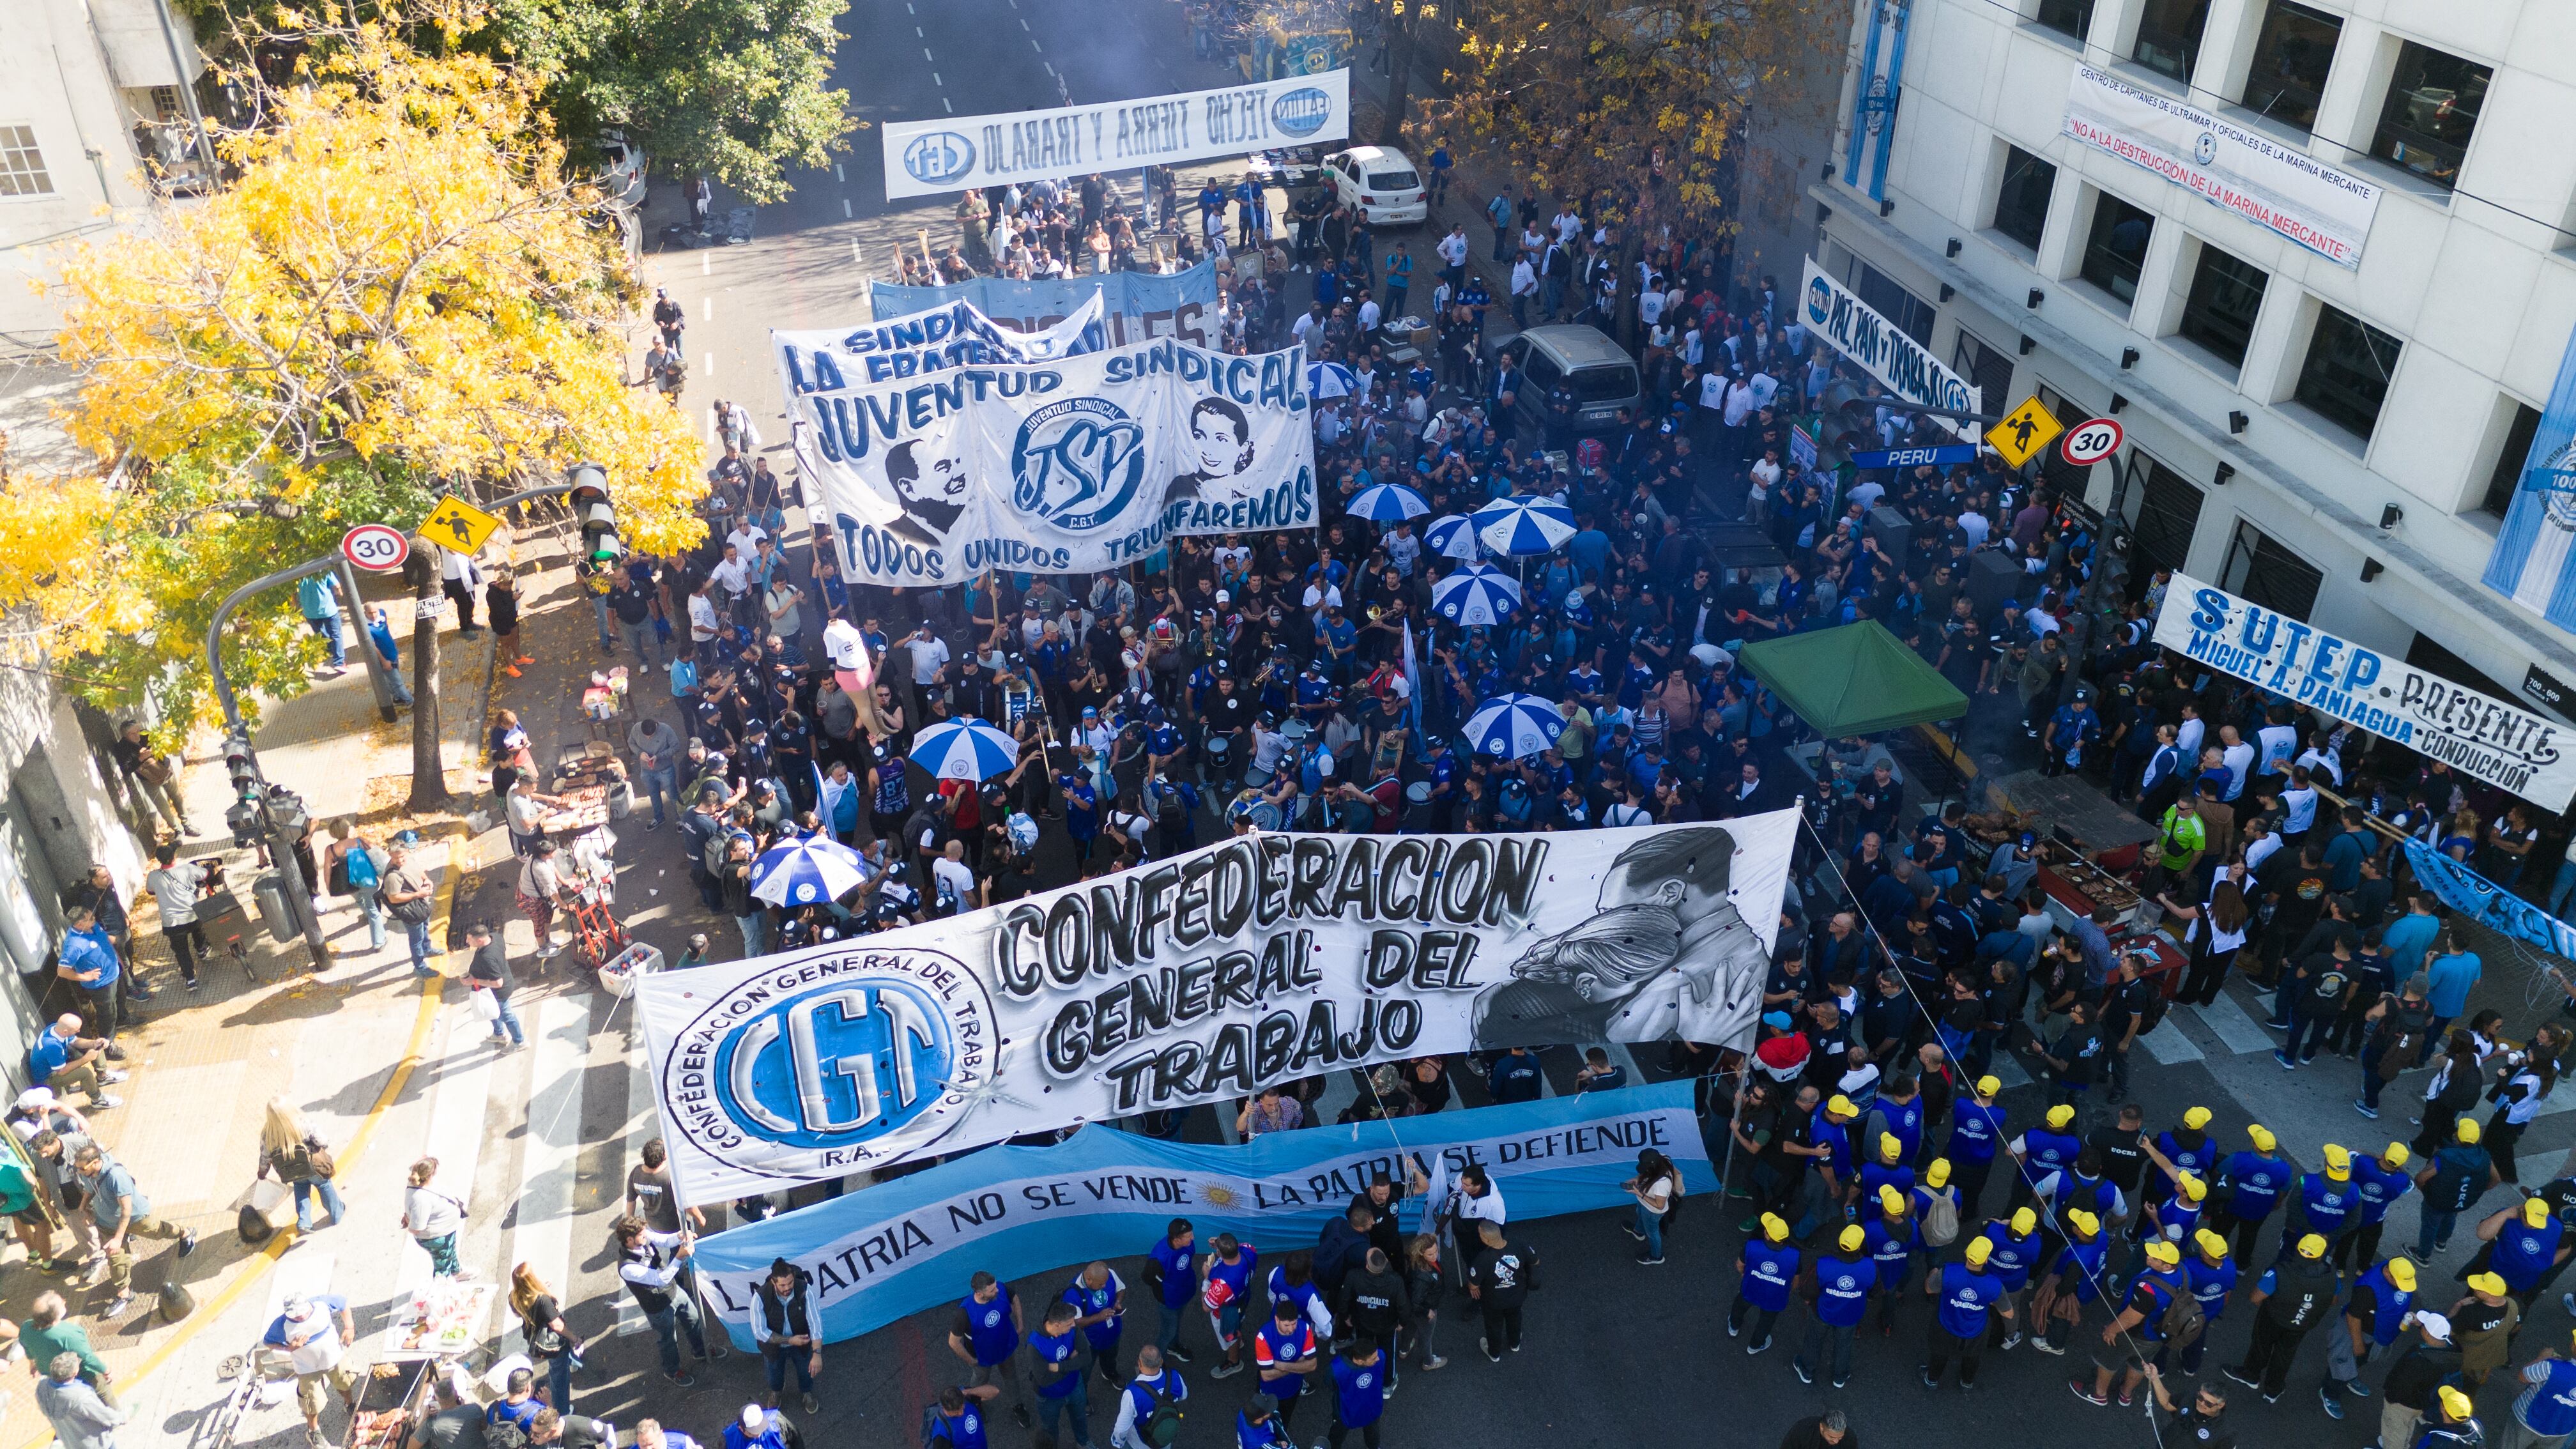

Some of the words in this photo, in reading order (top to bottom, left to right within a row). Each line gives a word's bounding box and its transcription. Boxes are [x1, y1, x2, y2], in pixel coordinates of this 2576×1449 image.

[2081, 68, 2108, 88] CENTRO
[2109, 79, 2120, 91] DE
[2120, 84, 2158, 109] CAPITANES
[2159, 100, 2169, 112] DE
[2170, 105, 2210, 129] ULTRAMAR
[2211, 121, 2218, 132] Y
[2219, 125, 2258, 150] OFICIALES
[2260, 142, 2272, 155] DE
[2274, 147, 2285, 160] LA
[2285, 152, 2318, 176] MARINA
[2320, 169, 2370, 199] MERCANTE
[2090, 125, 2097, 141] A
[2099, 132, 2112, 148] LA
[2113, 138, 2188, 183] DESTRUCCIÓN
[2190, 172, 2205, 191] DE
[2208, 182, 2221, 199] LA
[2223, 190, 2269, 223] MARINA
[784, 345, 847, 396] LA
[1855, 306, 1880, 367] PAN
[1889, 330, 1943, 408] TRABAJO
[814, 371, 1062, 463] JUVENTUD
[1105, 340, 1307, 411] SINDICAL
[1024, 401, 1071, 433] JUVENTUD
[1075, 400, 1120, 420] SINDICAL
[1887, 448, 1938, 466] PERU
[2075, 433, 2110, 452] 30
[837, 513, 944, 579] TODOS
[964, 539, 1070, 569] UNIDOS
[1105, 464, 1312, 562] TRIUNFAREMOS
[2064, 502, 2097, 530] Independencia
[2065, 496, 2084, 512] Avenida
[356, 537, 395, 559] 30
[2186, 629, 2262, 682] MIGUEL
[2299, 678, 2413, 743] PANIAGUA
[2402, 673, 2557, 757] PRESENTE
[2526, 685, 2545, 700] Comuna
[2529, 678, 2542, 690] 700
[2547, 689, 2560, 702] 600
[885, 776, 904, 797] 87
[2421, 730, 2529, 793] CONDUCCIÓN
[999, 836, 1549, 996] CONFEDERACION
[1047, 930, 1322, 1073] GENERAL
[1368, 928, 1483, 992] DEL
[680, 985, 769, 1149] CONFEDERACION
[776, 955, 915, 989] GENERAL
[921, 960, 963, 1002] DEL
[943, 1000, 984, 1107] TRABAO
[1107, 999, 1423, 1112] TRABAJO
[1253, 1183, 1305, 1209] LA
[1443, 1144, 1487, 1173] SE
[1499, 1116, 1670, 1164] DEFIENDE
[2111, 1147, 2136, 1156] UOCRA
[947, 1192, 1006, 1232] NO
[1026, 1181, 1075, 1211] SE
[1081, 1175, 1192, 1204] VENDE
[1356, 1296, 1389, 1307] JUDICIALES
